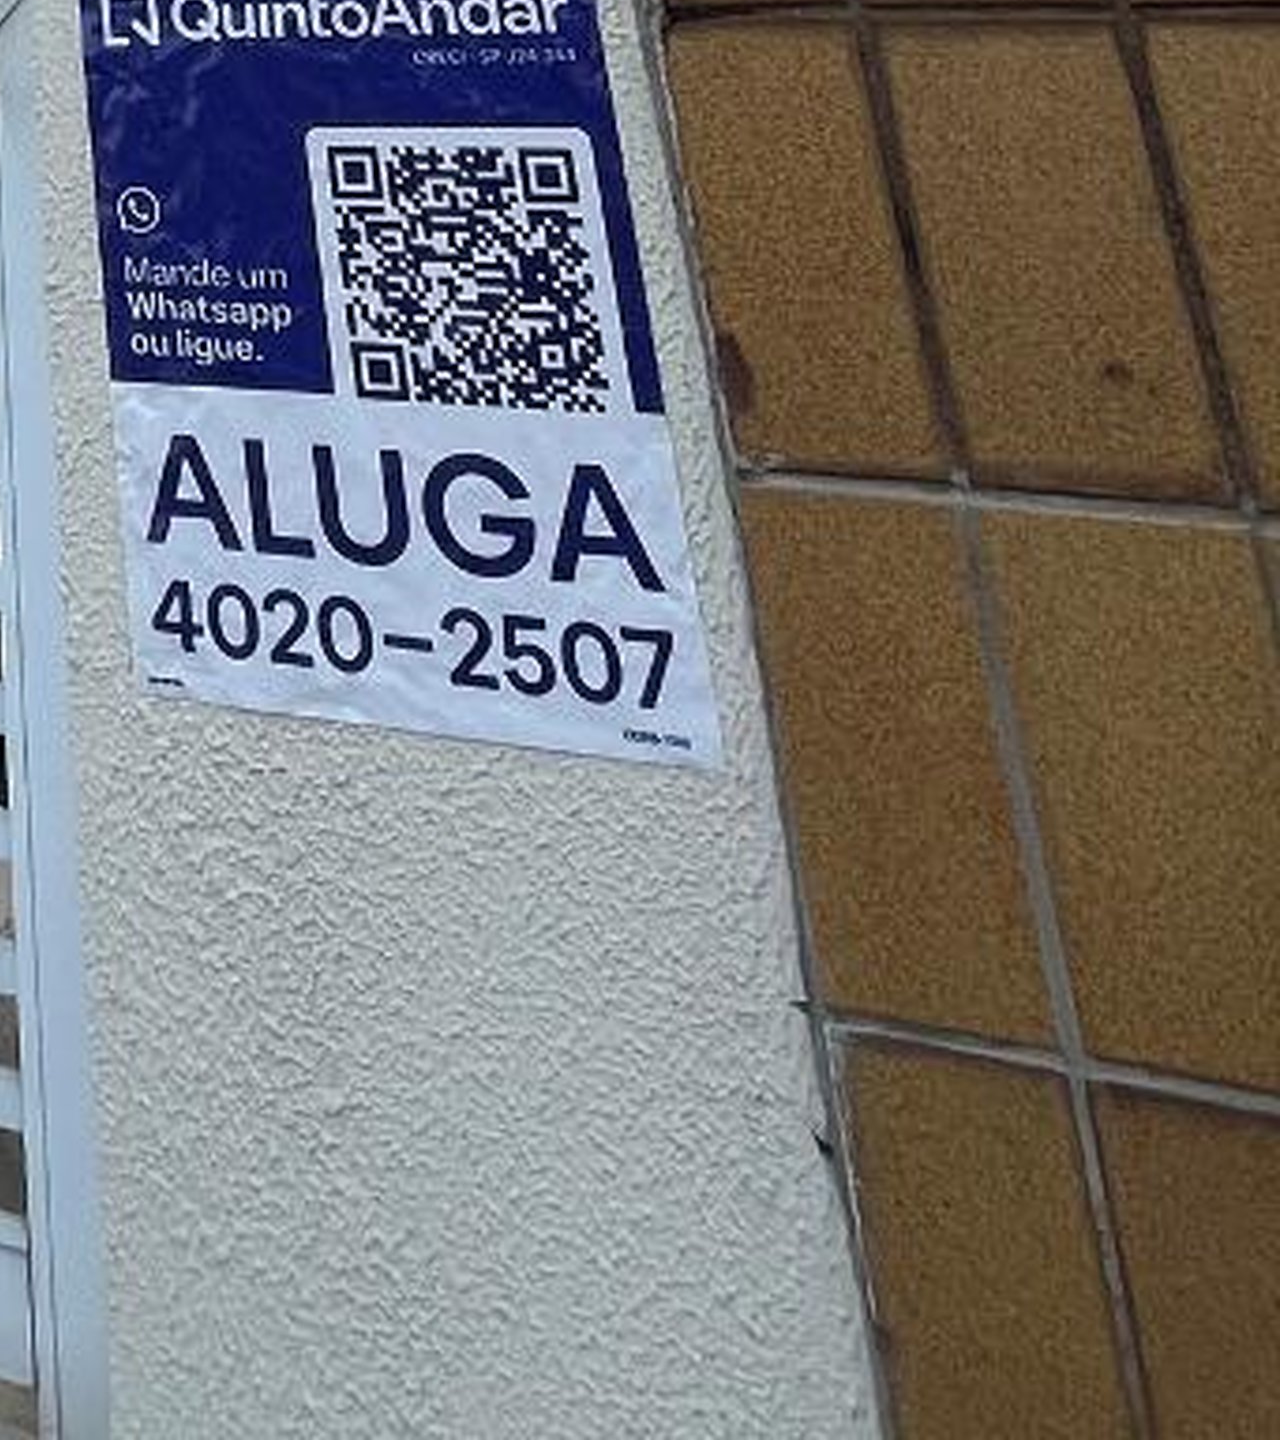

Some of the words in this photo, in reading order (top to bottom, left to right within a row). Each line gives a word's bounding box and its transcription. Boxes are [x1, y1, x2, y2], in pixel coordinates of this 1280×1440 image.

[124, 255, 231, 287] Mande
[237, 268, 288, 289] um
[124, 291, 292, 333] Whatsapp
[131, 332, 170, 357] ou
[177, 327, 265, 366] ligue.
[146, 434, 667, 592] ALUGA
[152, 580, 675, 710] 4020-2507
